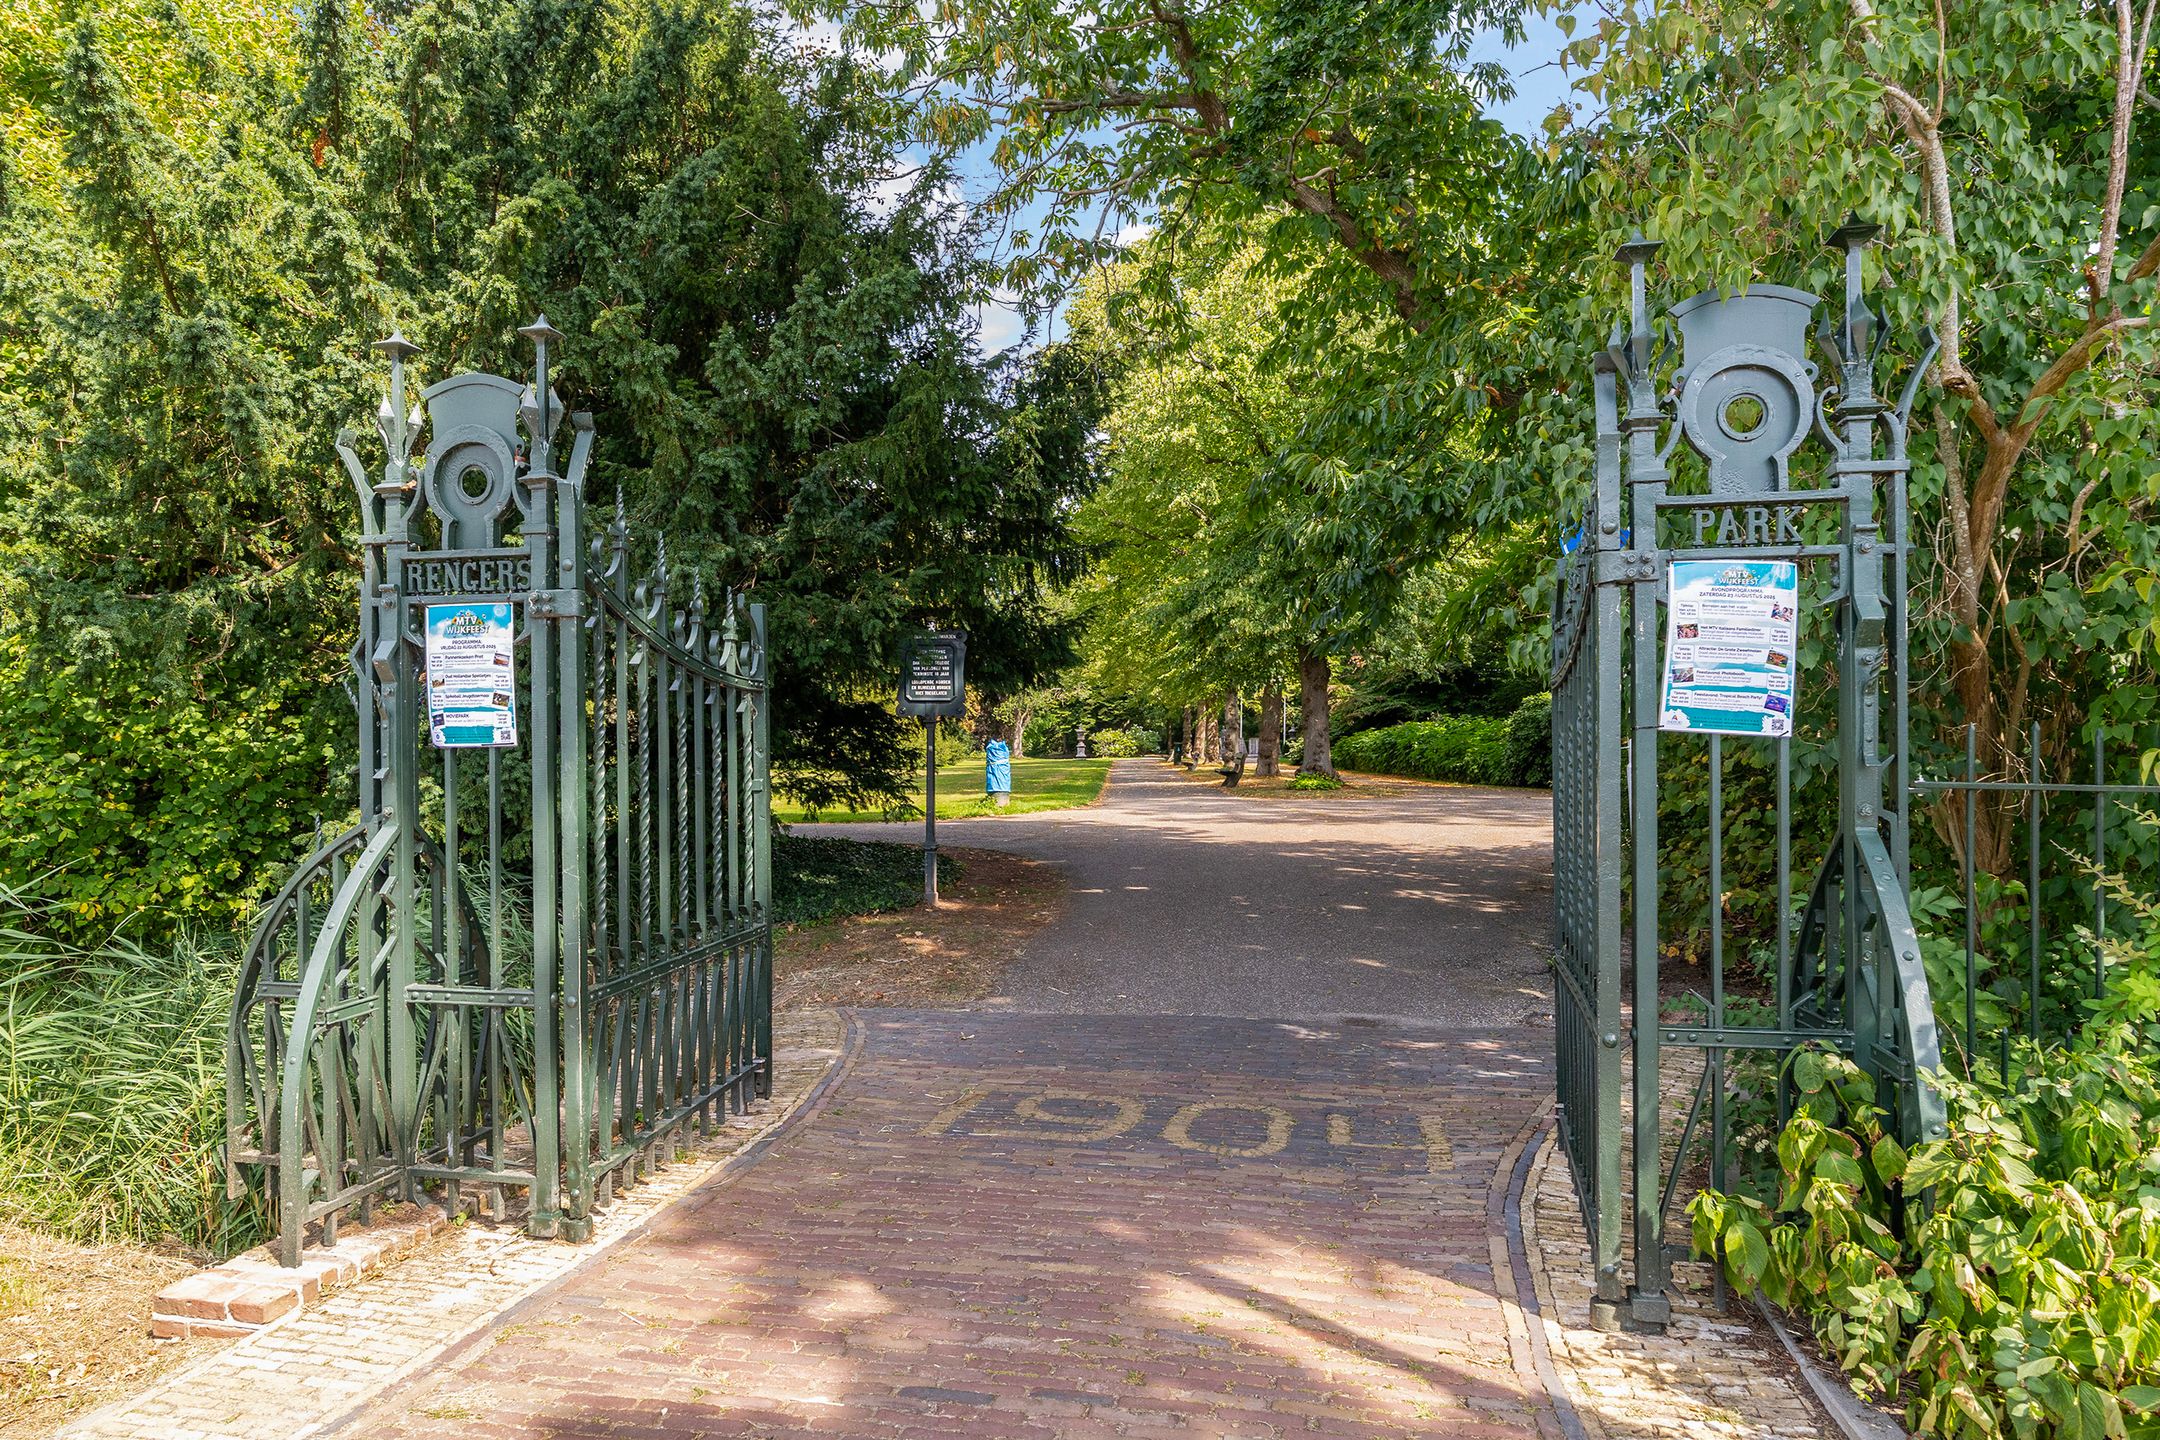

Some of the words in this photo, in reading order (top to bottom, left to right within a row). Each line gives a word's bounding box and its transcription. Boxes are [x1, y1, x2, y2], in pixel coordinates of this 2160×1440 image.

[1692, 504, 1803, 545] PARK
[406, 559, 531, 593] RENGERS
[1718, 577, 1760, 585] WIJKFEEST
[456, 616, 478, 626] MTV
[446, 625, 490, 635] WIJKFEEST
